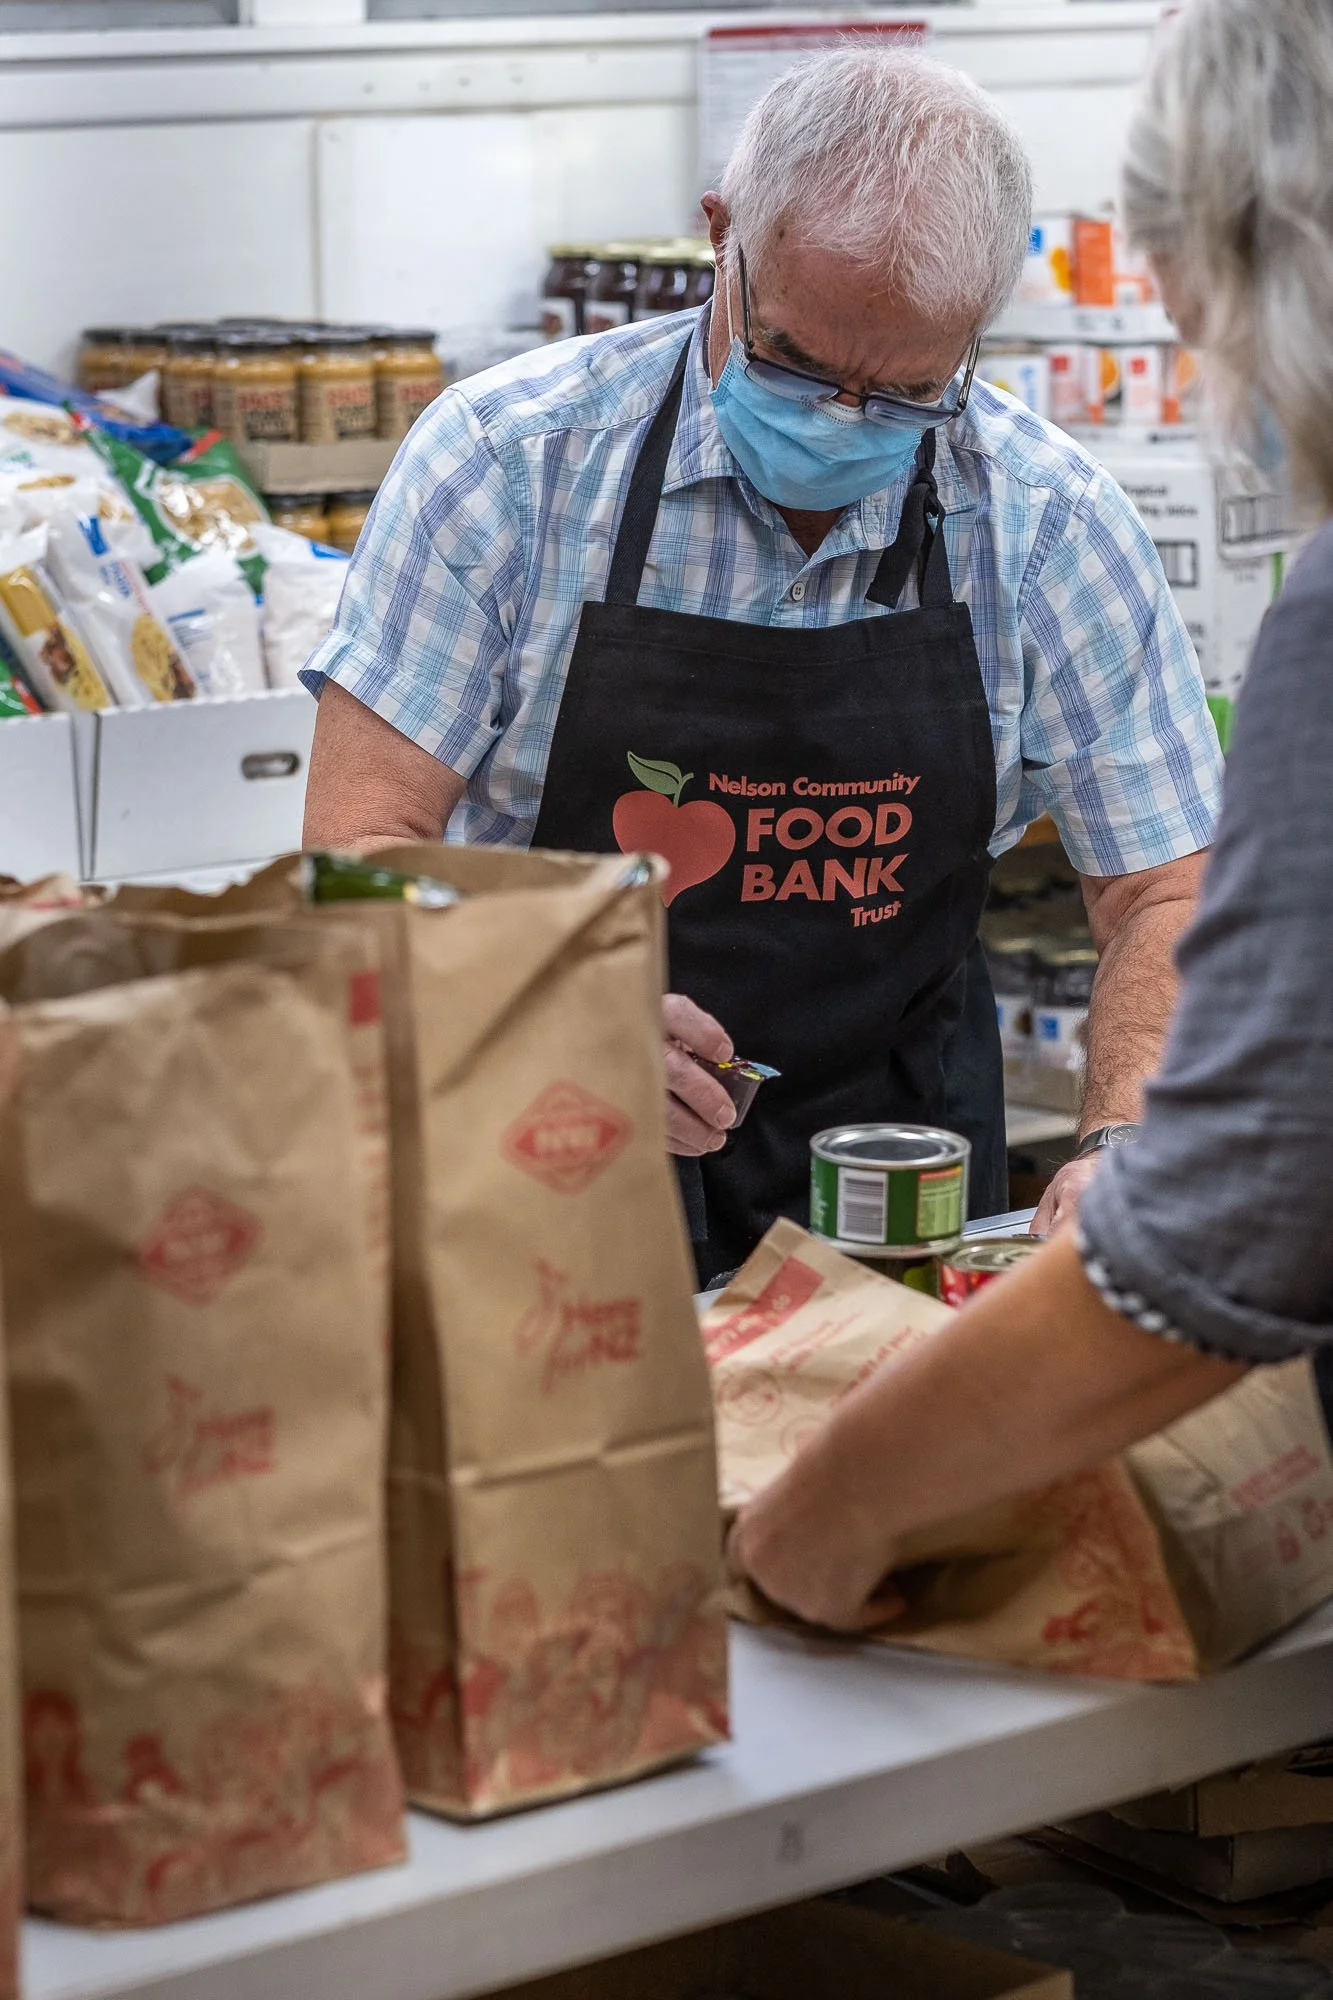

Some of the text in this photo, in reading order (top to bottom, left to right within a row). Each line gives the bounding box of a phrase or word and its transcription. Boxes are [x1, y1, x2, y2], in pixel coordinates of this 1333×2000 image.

[708, 771, 922, 797] Nelson Community
[746, 802, 913, 852] FOOD
[740, 853, 910, 902] BANK
[850, 900, 902, 928] Trust
